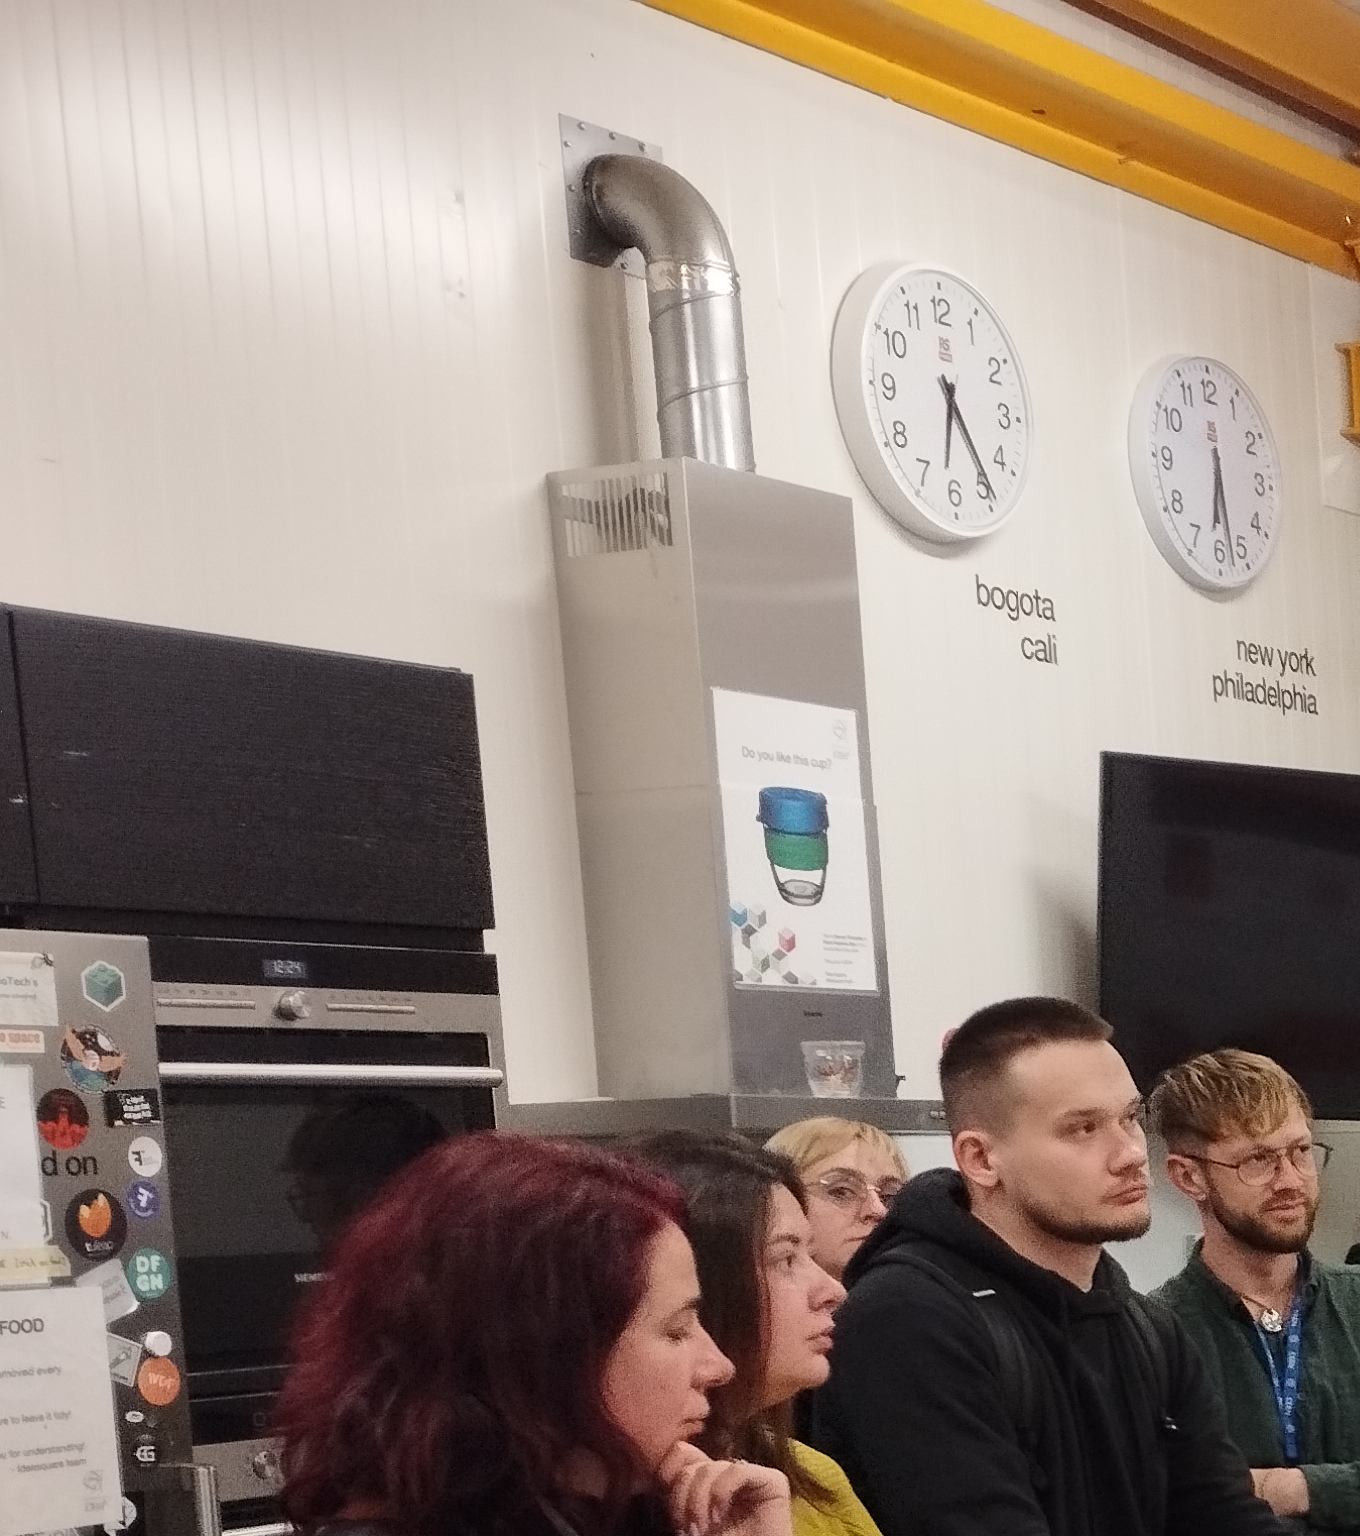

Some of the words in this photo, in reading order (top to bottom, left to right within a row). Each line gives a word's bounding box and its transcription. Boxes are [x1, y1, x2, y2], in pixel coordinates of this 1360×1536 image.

[975, 573, 1056, 623] bogota
[1020, 631, 1059, 666] cali
[1236, 637, 1274, 670] new
[1276, 644, 1317, 677] york
[1212, 670, 1319, 716] philadelphia
[742, 744, 755, 758] Do
[757, 750, 774, 762] you
[66, 1155, 98, 1176] on
[136, 1255, 161, 1273] DF
[136, 1274, 164, 1291] GN
